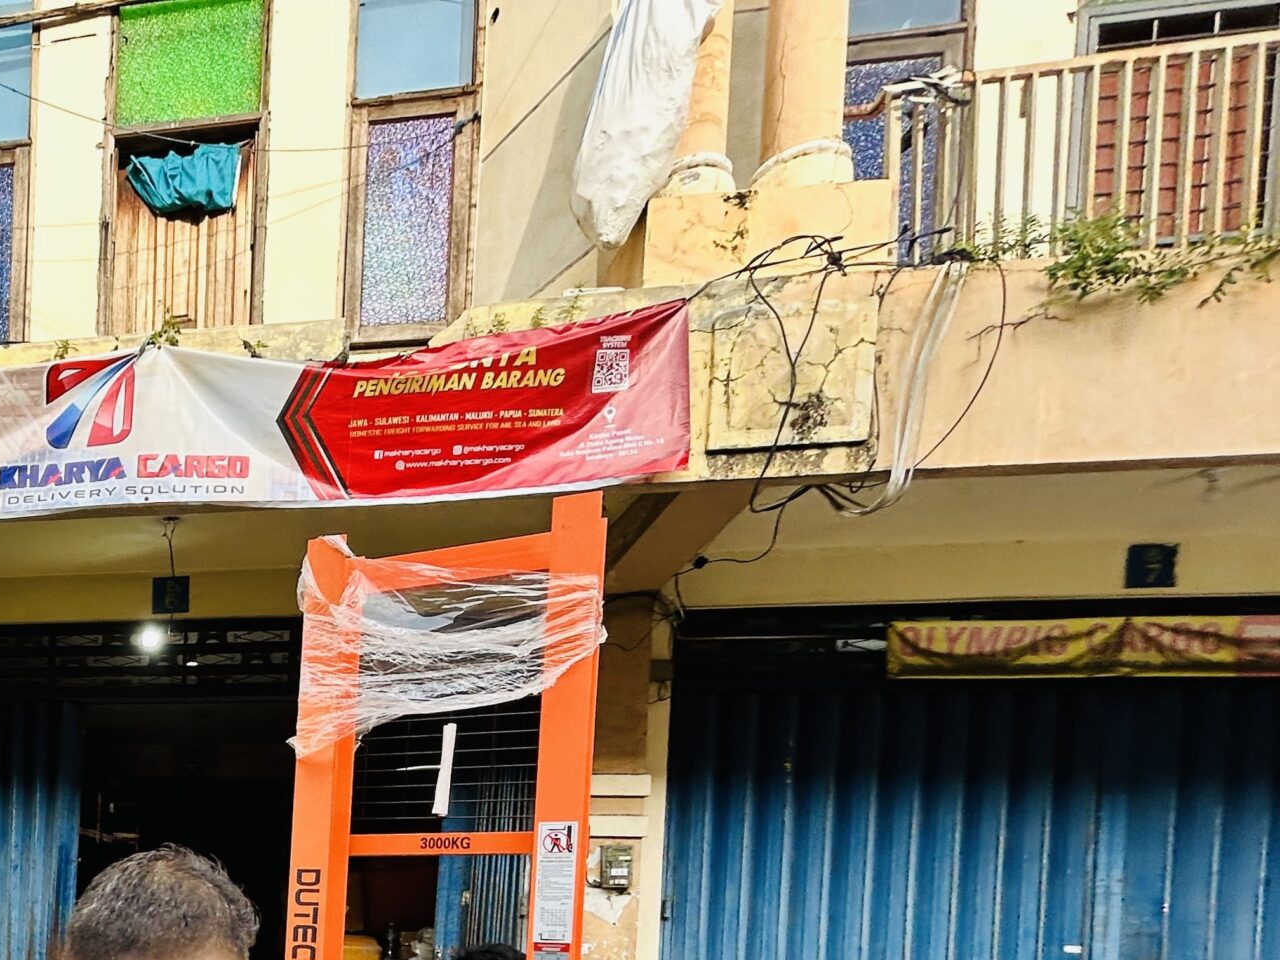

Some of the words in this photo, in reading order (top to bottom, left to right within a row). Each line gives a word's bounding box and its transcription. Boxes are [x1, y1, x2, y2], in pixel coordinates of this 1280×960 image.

[352, 372, 476, 398] PENGIRIMAN
[480, 368, 565, 389] BARANG
[348, 418, 368, 428] JAWA
[374, 415, 410, 426] SULAWESI
[416, 412, 459, 423] KALIMANTAN
[465, 410, 493, 420] MALUKU
[499, 409, 522, 419] PAPUA
[528, 408, 564, 418] SUMATERA
[136, 454, 250, 479] CARGO
[7, 487, 118, 506] DELIVERY
[124, 484, 246, 499] SOLUTION
[420, 836, 471, 850] 3000KG
[291, 868, 321, 960] DUTEC
